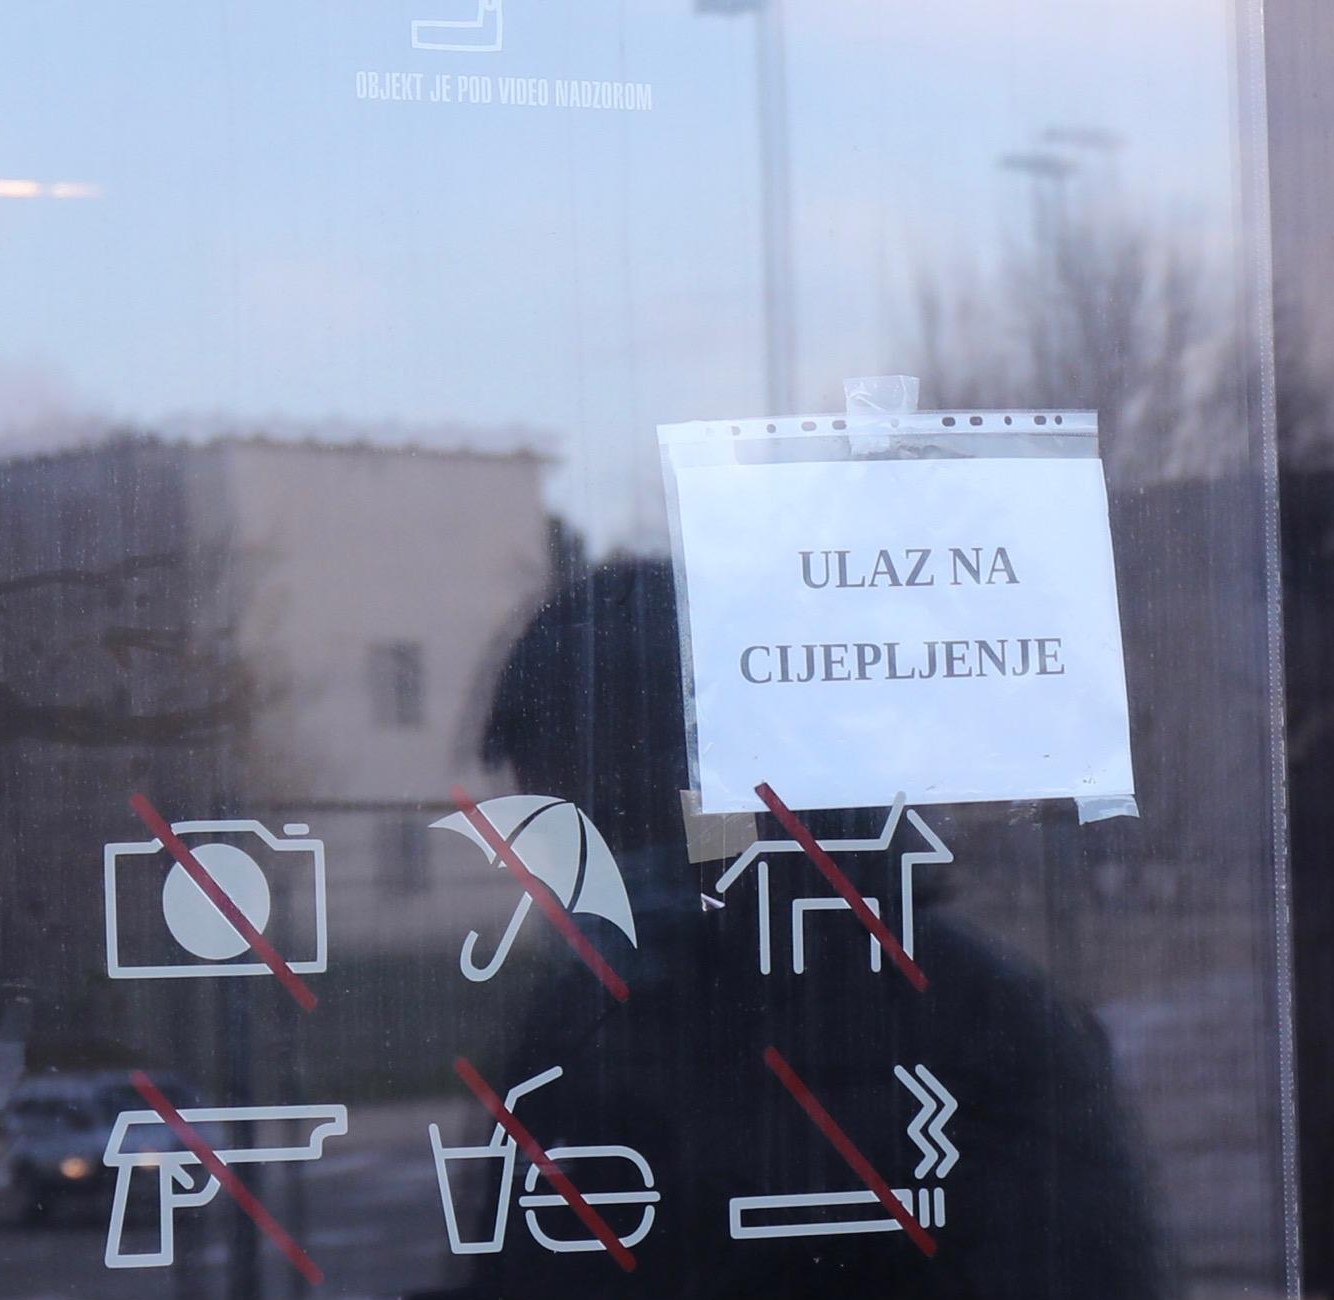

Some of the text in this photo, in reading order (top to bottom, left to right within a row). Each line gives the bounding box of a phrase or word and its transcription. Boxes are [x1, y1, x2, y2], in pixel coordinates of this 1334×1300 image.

[355, 70, 652, 110] OBJEKT JE POD VIDEO NADZOROM
[799, 547, 1020, 589] ULAZ NA
[739, 638, 1065, 684] CIJEPLJENJE
